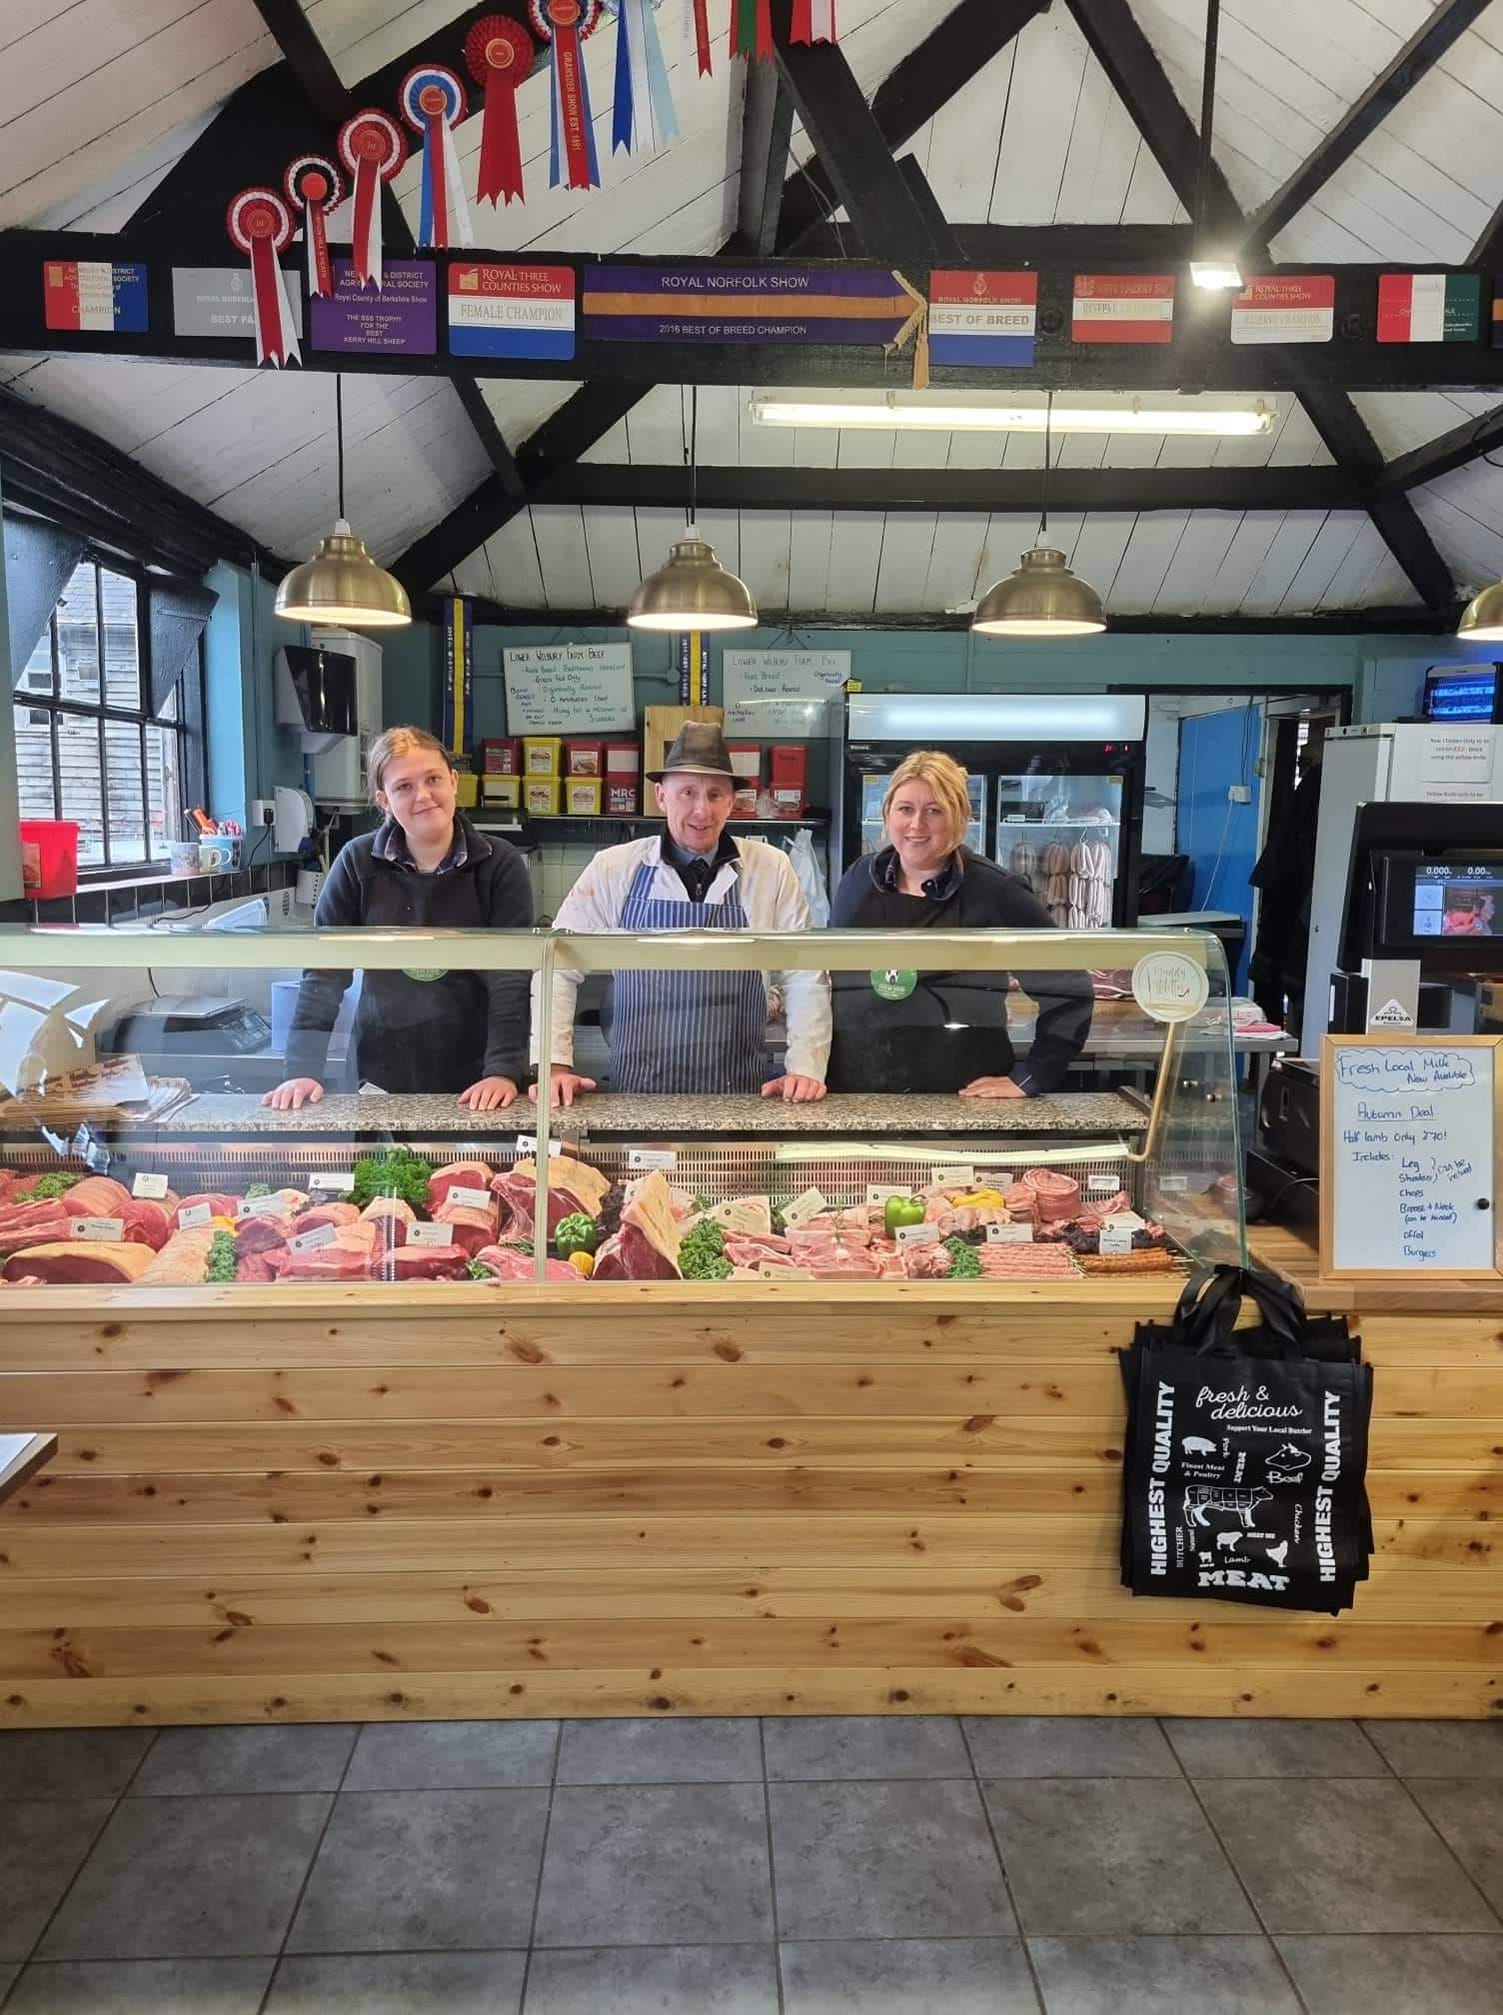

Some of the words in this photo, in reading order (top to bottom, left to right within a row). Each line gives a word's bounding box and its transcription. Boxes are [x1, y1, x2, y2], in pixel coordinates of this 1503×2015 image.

[390, 271, 424, 280] DISTRICT
[481, 267, 518, 282] ROYAL
[520, 271, 550, 282] THREE
[397, 280, 430, 289] SOCIETY
[482, 280, 531, 292] COUNTIES
[531, 282, 562, 294] SHOW
[661, 276, 705, 288] ROYAL
[706, 276, 768, 288] NORFOLK
[770, 277, 810, 289] SHOW
[334, 293, 352, 302] Royal
[352, 293, 374, 304] County
[345, 313, 360, 321] THE
[460, 303, 504, 319] FEMALE
[506, 306, 561, 321] CHAMPION
[375, 322, 390, 330] THE
[966, 314, 983, 325] OF
[986, 315, 1030, 326] BREED
[682, 325, 706, 335] BEST
[708, 325, 722, 335] OF
[723, 325, 756, 335] BREED
[757, 325, 807, 335] CHAMPION
[383, 338, 406, 346] SHEEP
[610, 787, 636, 798] MRC
[1426, 866, 1450, 875] 0.000
[1467, 866, 1486, 875] 0.00
[1340, 1055, 1380, 1078] Fresh
[1384, 1058, 1415, 1073] Local
[1423, 1055, 1450, 1070] Milk
[1406, 1073, 1428, 1085] Now
[1357, 1101, 1403, 1119] Autumn
[1410, 1105, 1435, 1118] Deal
[1343, 1129, 1361, 1144] Half
[1401, 1157, 1420, 1172] Leg
[1434, 1202, 1455, 1211] Neck
[1403, 1244, 1437, 1262] Burgers
[1195, 1385, 1251, 1408] fresh
[1255, 1384, 1270, 1401] &
[1210, 1401, 1304, 1420] delicious
[1151, 1381, 1176, 1475] QUALITY
[1226, 1424, 1251, 1433] Support
[1251, 1424, 1269, 1433] Your
[1269, 1425, 1288, 1434] Local
[1287, 1426, 1313, 1435] Butcher
[1321, 1390, 1342, 1482] QUALITY
[1221, 1437, 1231, 1459] Pork
[1181, 1461, 1204, 1471] Finest
[1205, 1463, 1226, 1471] Meat
[1193, 1470, 1222, 1480] Poultry
[1148, 1478, 1167, 1576] HIGHEST
[1294, 1503, 1304, 1545] Chicken
[1314, 1485, 1337, 1583] HIGHEST
[1175, 1526, 1185, 1568] BUTCHER
[1224, 1555, 1251, 1565] Lamb
[1197, 1569, 1291, 1592] MEAT
